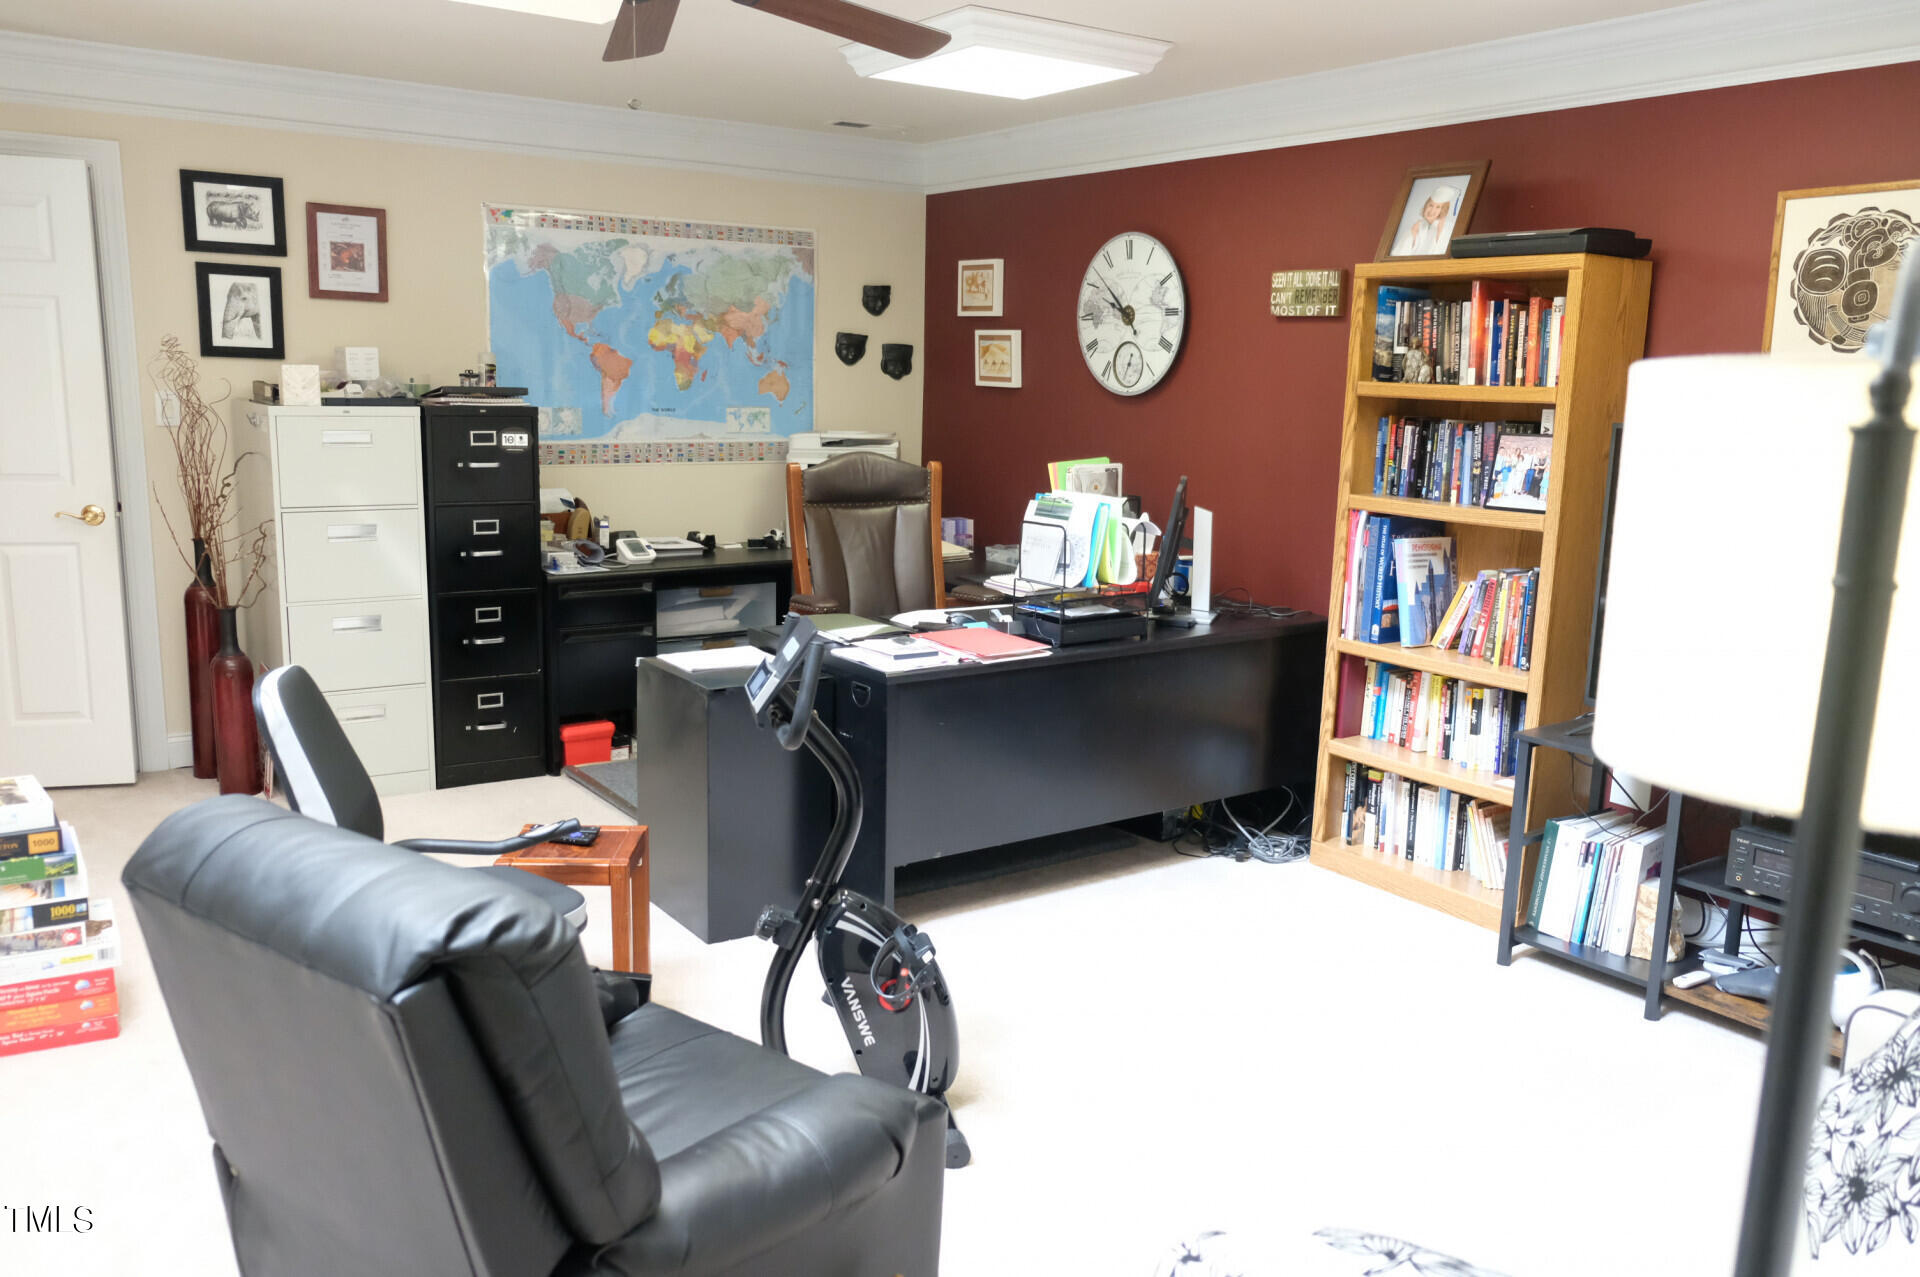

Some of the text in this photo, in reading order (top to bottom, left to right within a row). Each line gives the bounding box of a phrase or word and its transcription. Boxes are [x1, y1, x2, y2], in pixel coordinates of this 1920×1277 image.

[1272, 271, 1339, 288] SEEN IT ALL DONE IT ALL
[1271, 289, 1338, 304] CAN'T REMEMBER
[1271, 305, 1337, 316] MOST OF IT
[1376, 556, 1386, 581] WORLD
[1372, 581, 1383, 610] HISTORY
[32, 837, 55, 849] 1000
[50, 903, 76, 918] 1000
[841, 976, 876, 1047] VANSWE
